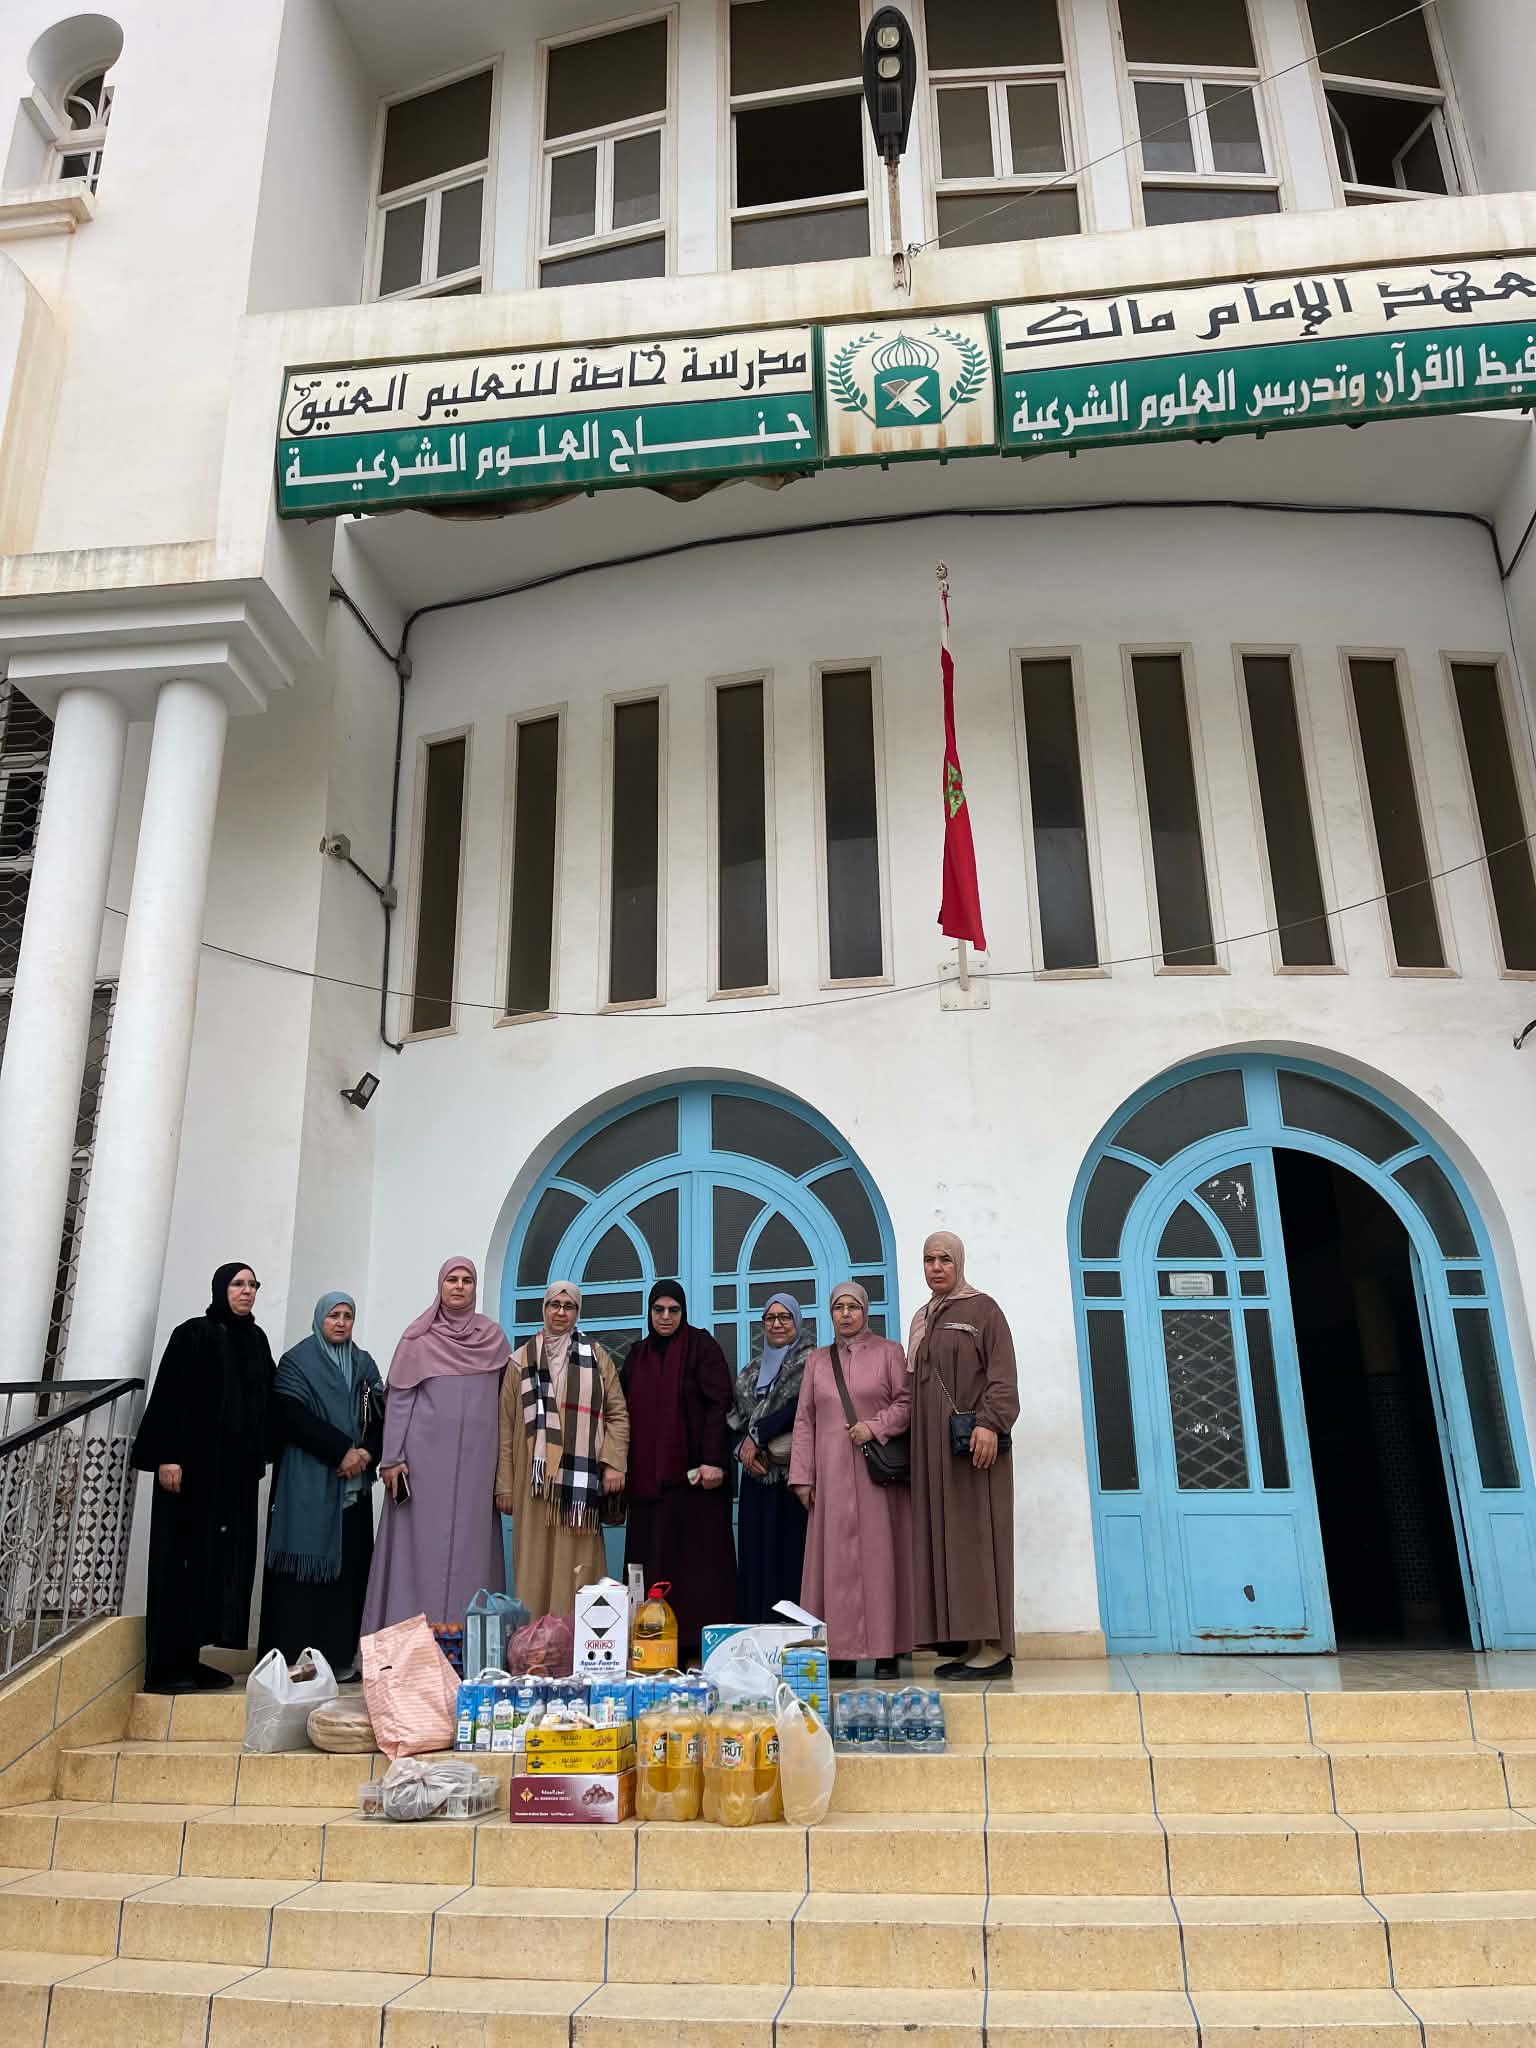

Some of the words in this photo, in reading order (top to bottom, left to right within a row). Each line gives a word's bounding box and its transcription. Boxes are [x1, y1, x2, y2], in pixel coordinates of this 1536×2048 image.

[1196, 278, 1353, 339] الإمام
[1376, 268, 1536, 321] عهد
[1005, 300, 1174, 349] مالك
[417, 357, 559, 419] للتعليم
[570, 345, 664, 392] خاصة
[681, 347, 807, 391] مدرسة
[1246, 365, 1365, 415] وتدريس
[1376, 343, 1464, 402] القرآن
[1475, 336, 1536, 393] فيظ
[287, 373, 406, 434] العتيق
[1014, 380, 1128, 439] الشرعية
[1139, 369, 1235, 429] العلوم
[285, 434, 466, 490] الشرعية
[475, 421, 599, 478] العلوم
[587, 1640, 613, 1649] KIRIKO
